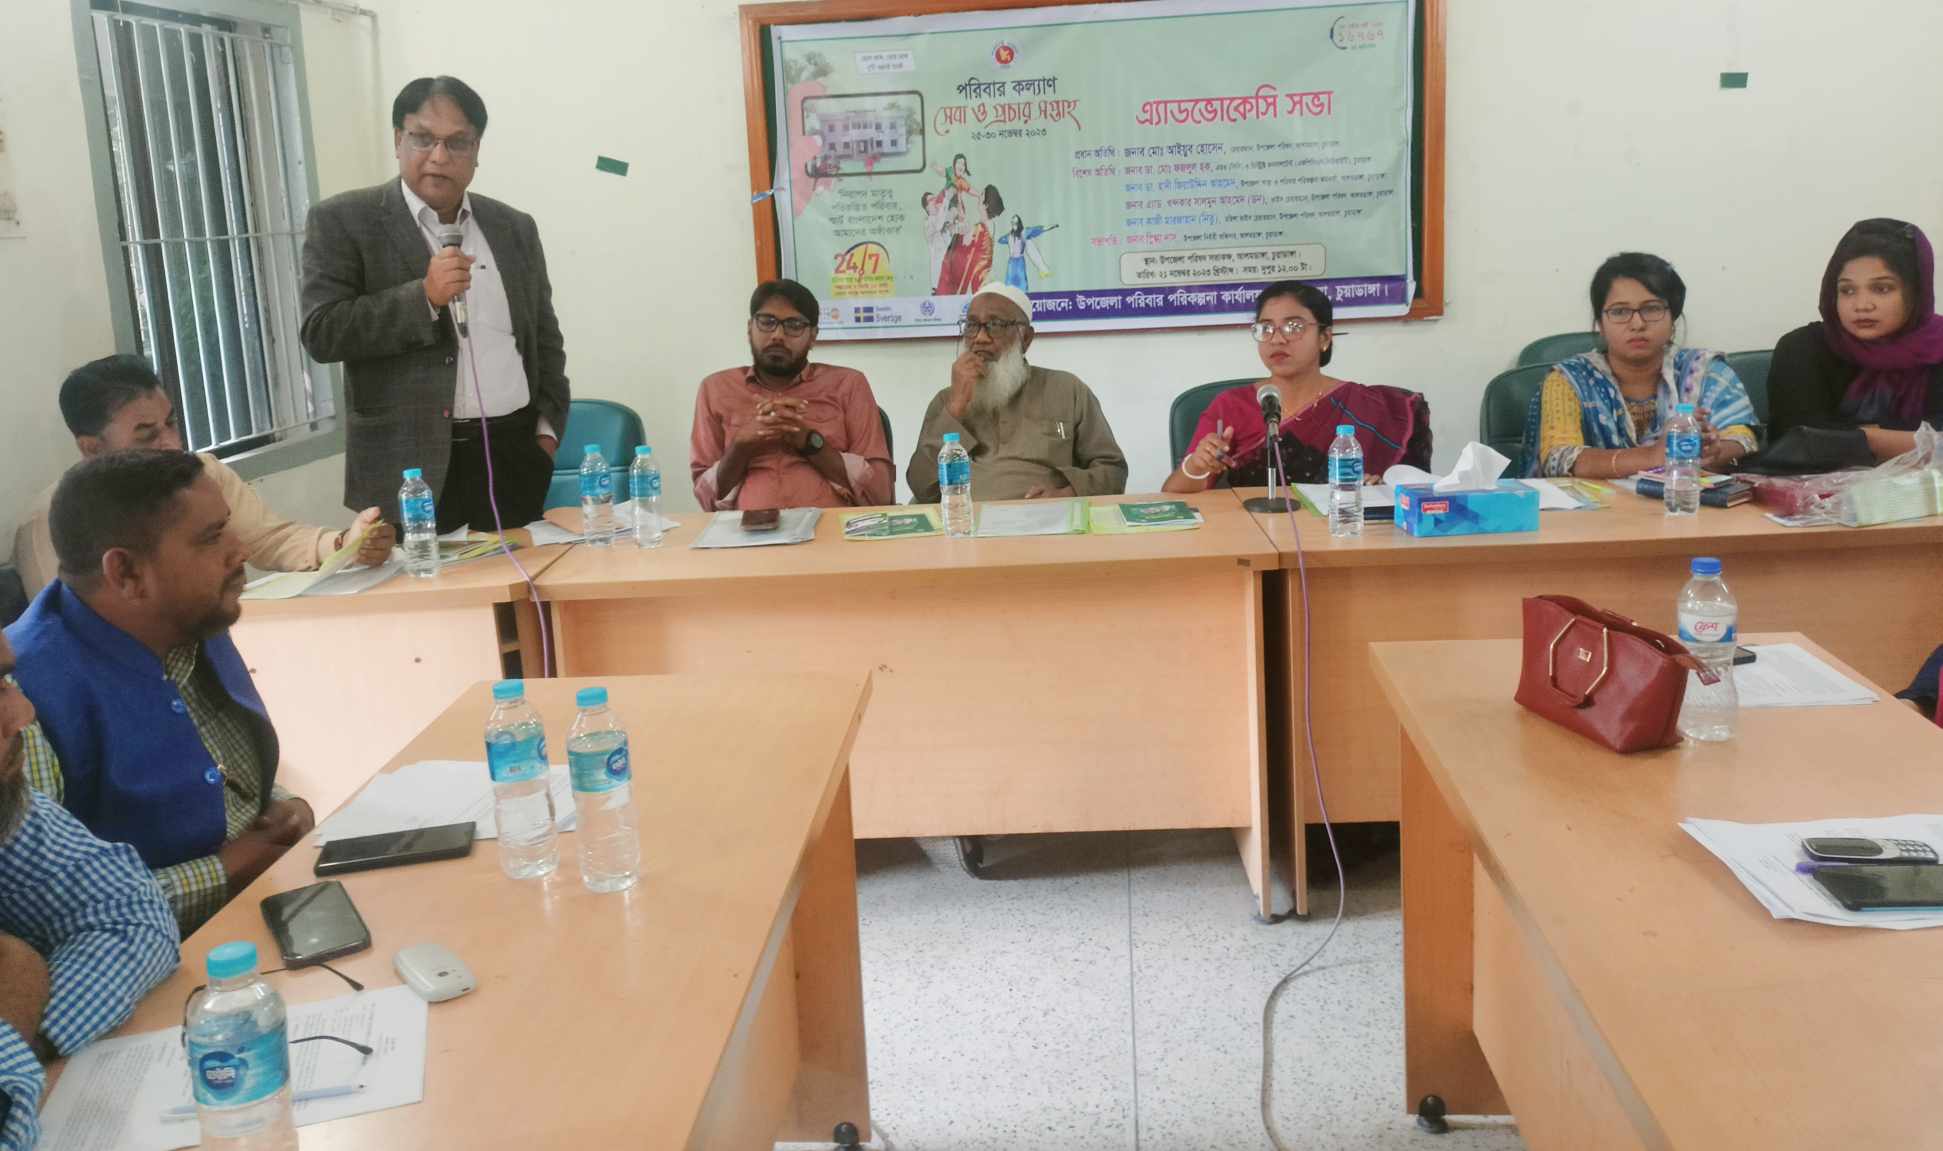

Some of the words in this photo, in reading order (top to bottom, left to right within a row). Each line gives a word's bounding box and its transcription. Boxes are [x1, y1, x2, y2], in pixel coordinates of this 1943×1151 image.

[956, 77, 1006, 100] পরিবার
[1011, 76, 1058, 97] কল্যাণ
[934, 105, 969, 136] সেবা
[971, 102, 988, 123] ও
[984, 101, 1034, 129] প্রচার
[1038, 99, 1081, 131] সপ্তাহ
[1135, 84, 1279, 126] এ্যাডভোকেসি
[1285, 90, 1335, 117] সভা
[1031, 297, 1073, 313] য়োজনে:
[1076, 294, 1122, 312] উপজেলা
[1126, 291, 1164, 309] পরিবার
[1167, 288, 1218, 308] পরিকল্পনা
